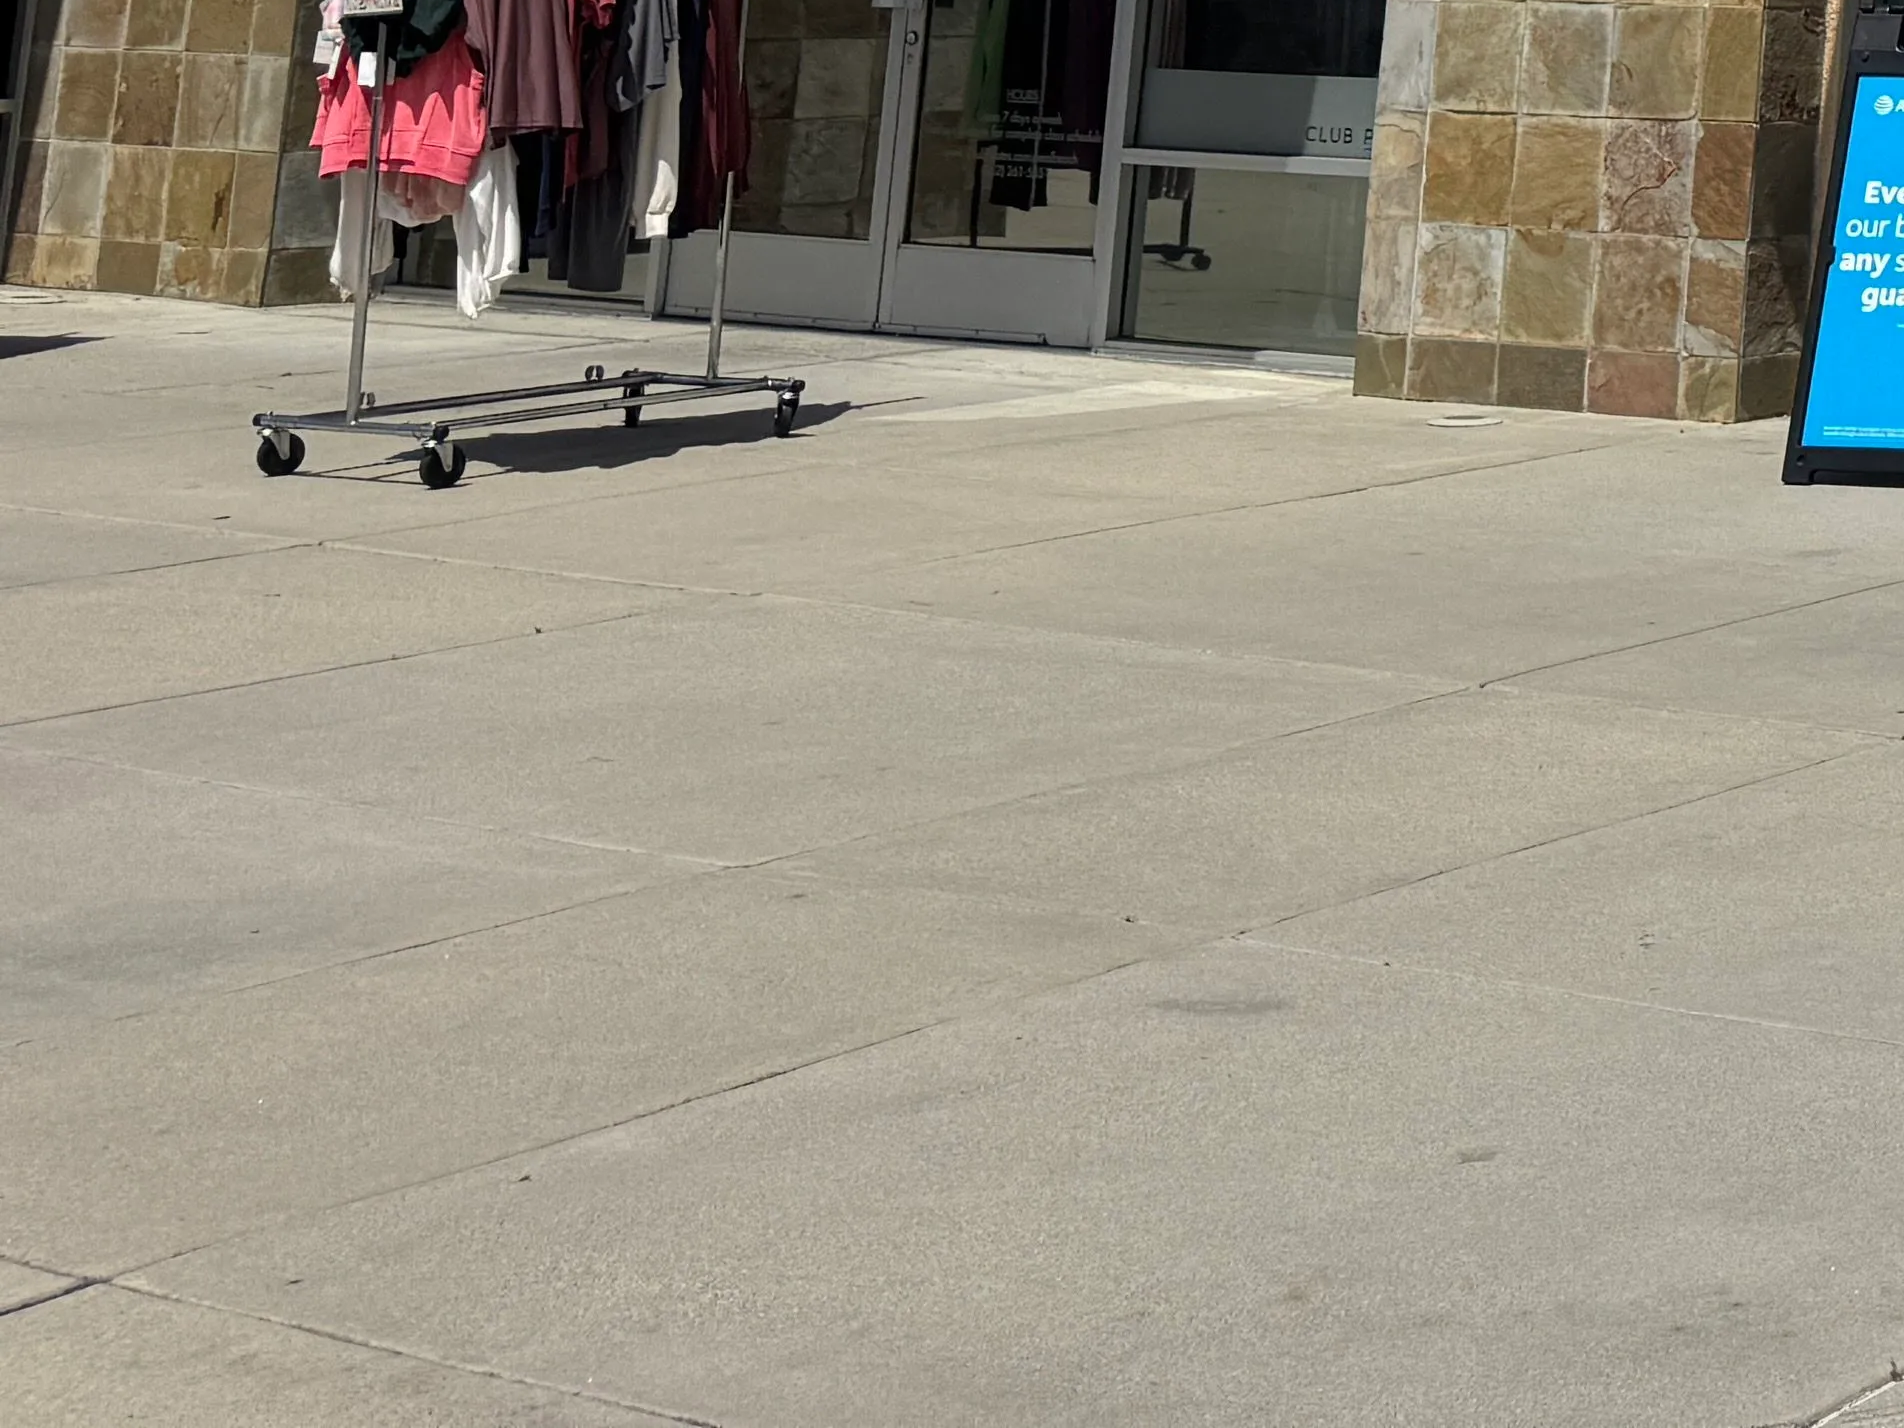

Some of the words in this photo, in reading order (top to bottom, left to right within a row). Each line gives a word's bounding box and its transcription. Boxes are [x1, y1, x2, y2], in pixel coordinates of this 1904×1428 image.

[1305, 126, 1353, 144] CLUB
[1845, 218, 1891, 238] our
[1839, 251, 1891, 279] any
